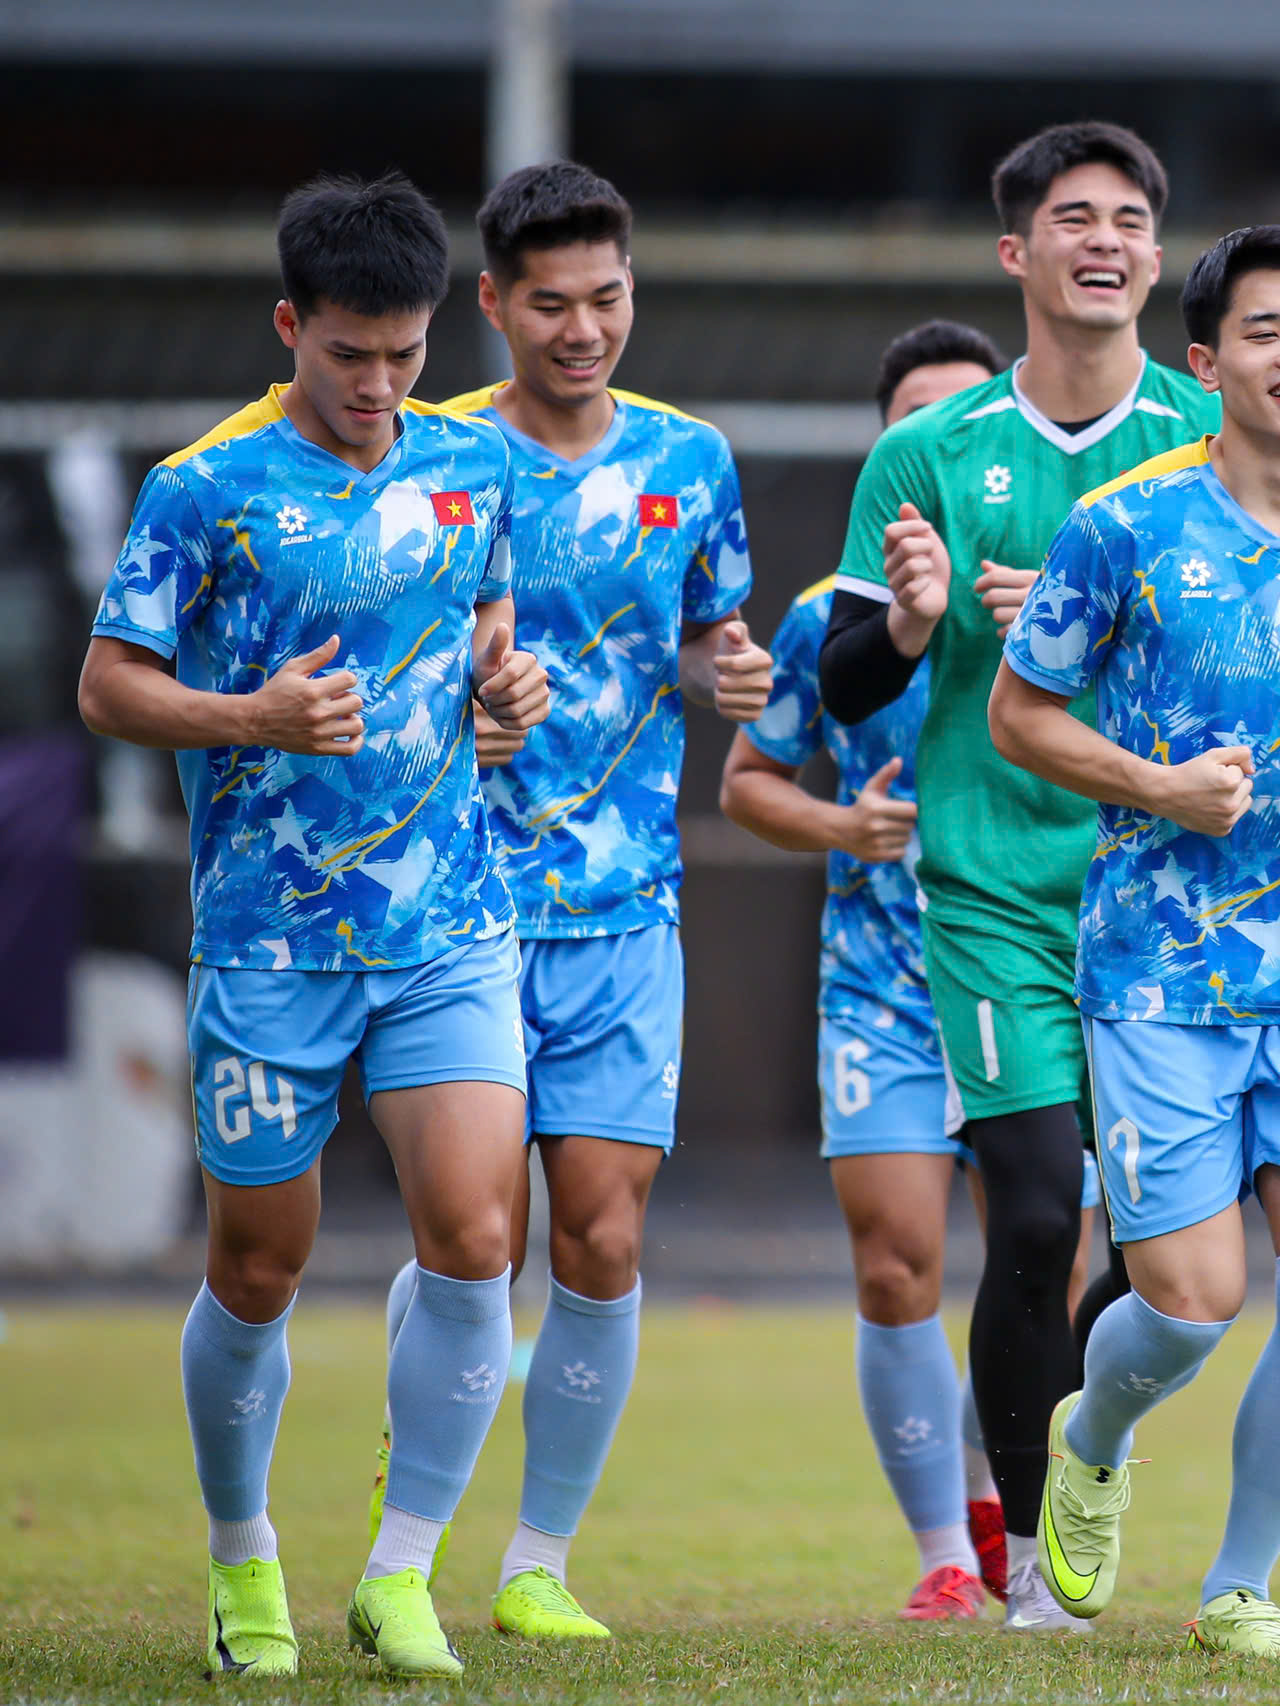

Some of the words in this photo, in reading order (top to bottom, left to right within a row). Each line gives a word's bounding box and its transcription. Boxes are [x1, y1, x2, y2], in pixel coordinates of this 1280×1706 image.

[834, 1037, 872, 1117] 6
[977, 998, 1000, 1082] 1
[215, 1056, 297, 1144] 24
[1108, 1116, 1142, 1205] 7
